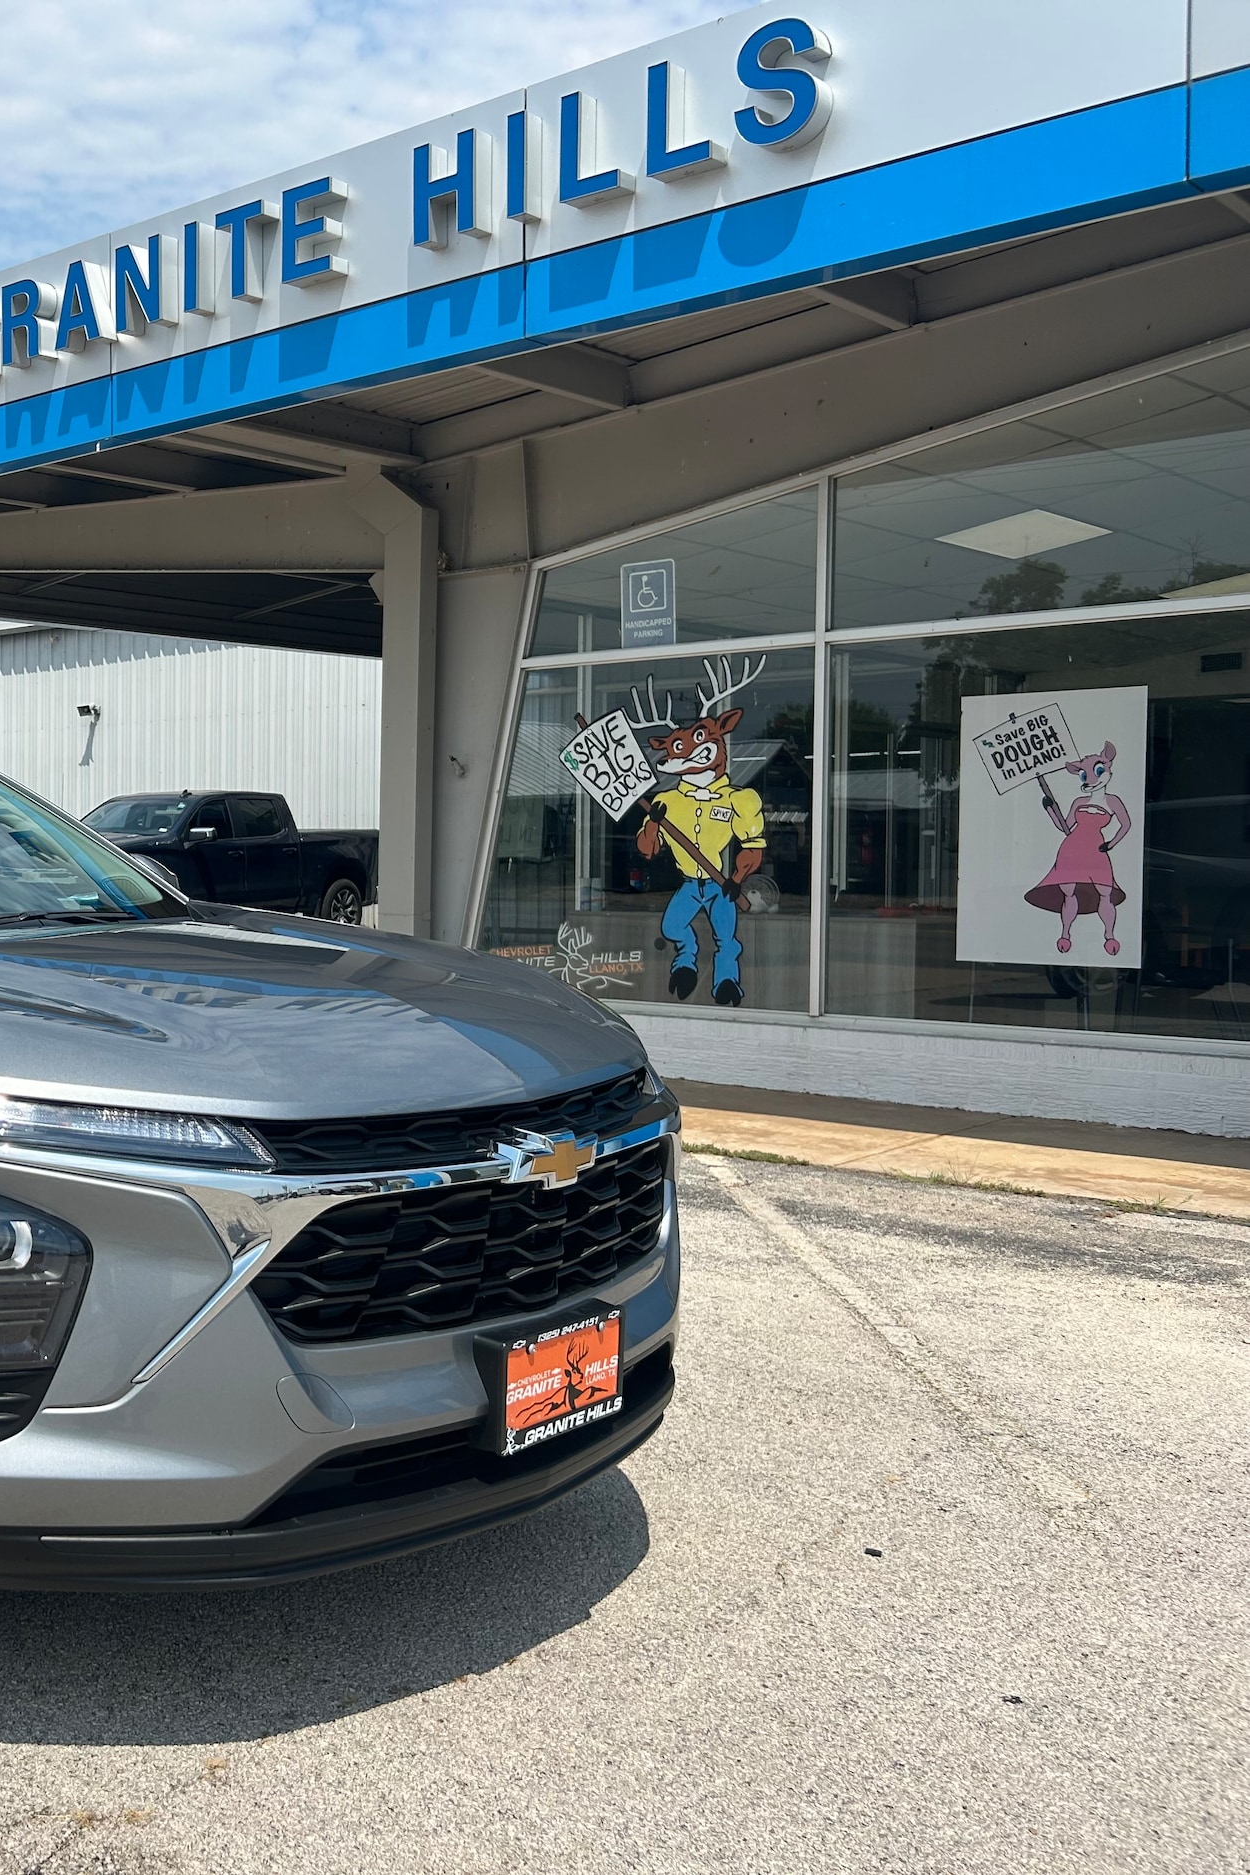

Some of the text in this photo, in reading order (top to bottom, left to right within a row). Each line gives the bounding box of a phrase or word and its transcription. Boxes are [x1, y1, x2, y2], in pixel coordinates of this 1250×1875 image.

[412, 17, 833, 251] HILLS
[625, 617, 672, 629] HANDICAPPED
[633, 628, 663, 638] PARKING
[995, 727, 1026, 745] Save
[1026, 714, 1049, 732] BIG
[991, 726, 1060, 769] DOUGH
[1001, 744, 1067, 780] in LLANO!
[583, 742, 634, 790] BIG
[602, 761, 652, 812] BUCKS
[589, 962, 644, 975] LLANO, TX
[591, 951, 641, 964] HILLS
[537, 1328, 561, 1342] (325)
[506, 1355, 619, 1405] GRANITE HILLS
[517, 1369, 551, 1387] CHEVROLET
[585, 1367, 617, 1386] LLANO, TX
[524, 1396, 623, 1444] GRANITE HILLS
